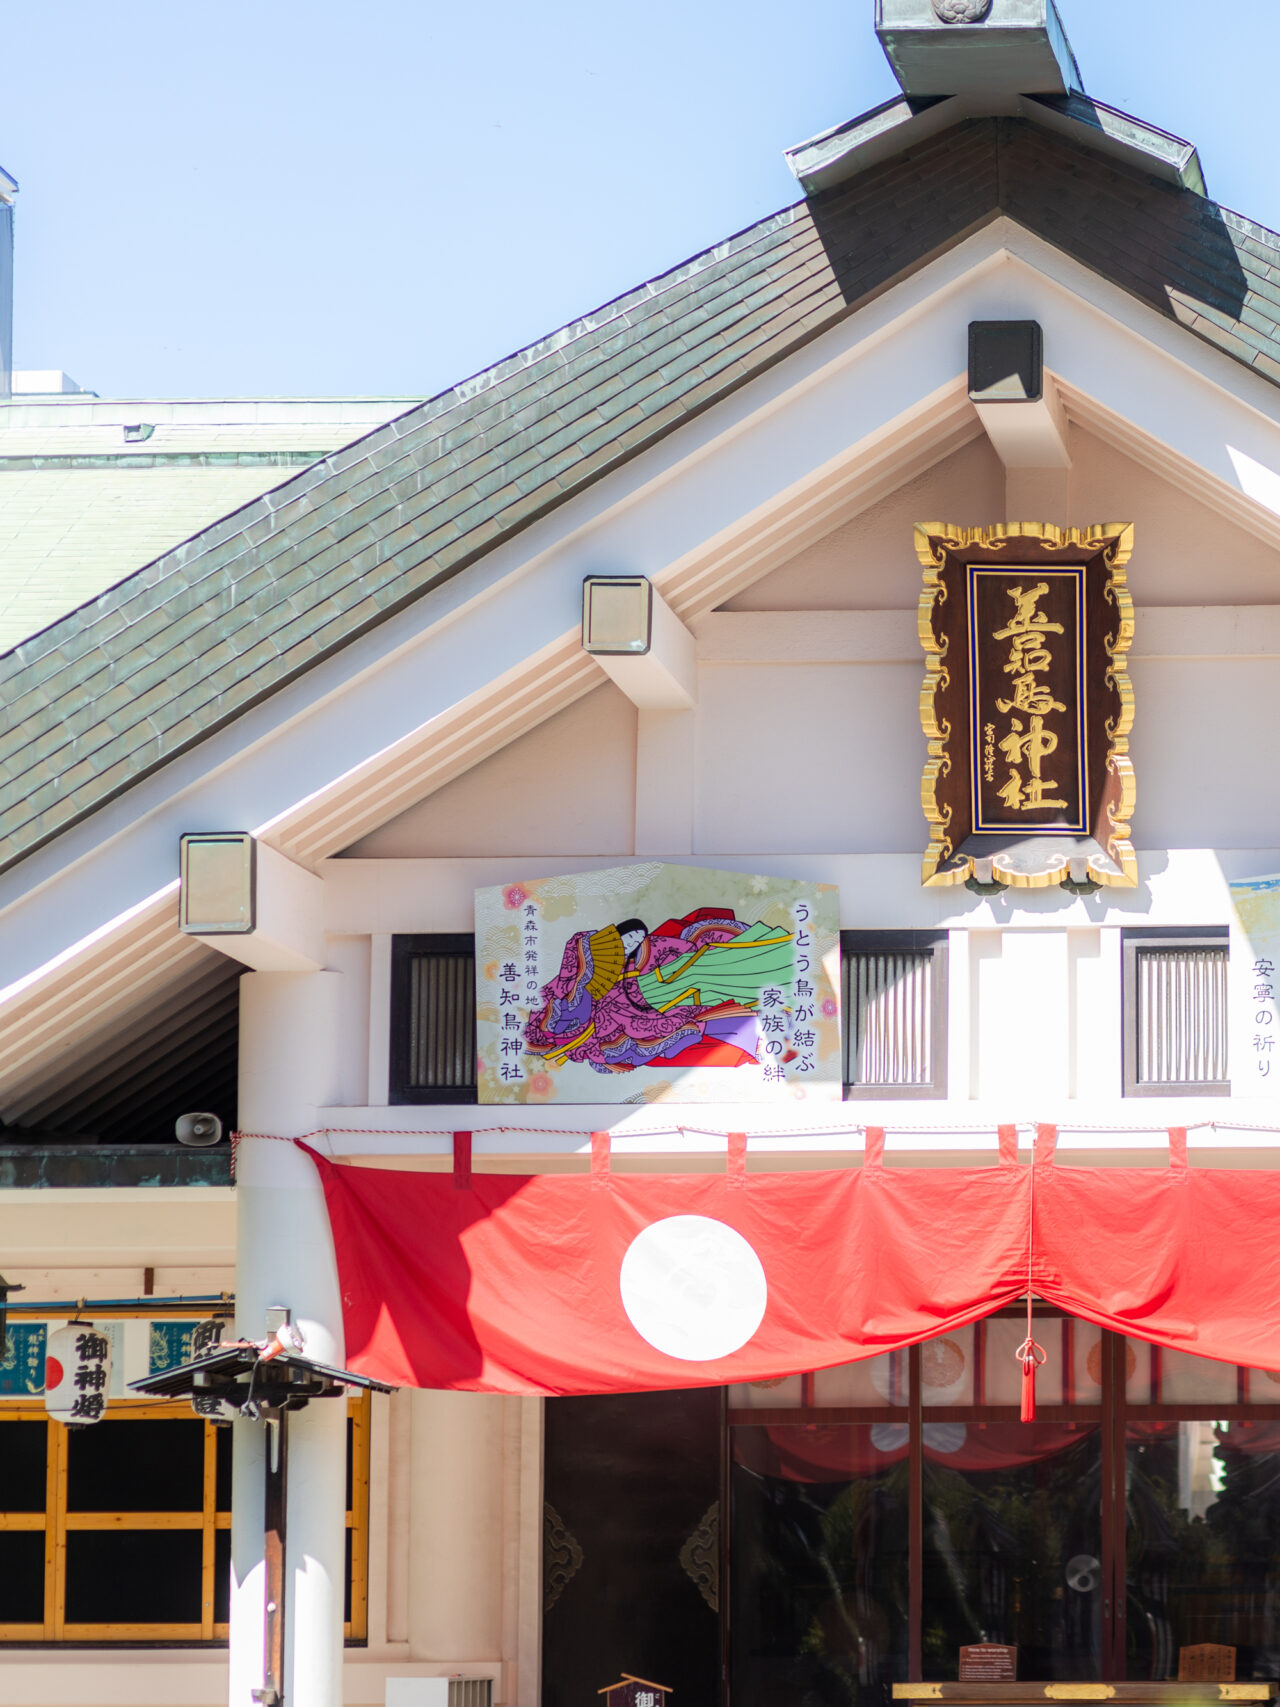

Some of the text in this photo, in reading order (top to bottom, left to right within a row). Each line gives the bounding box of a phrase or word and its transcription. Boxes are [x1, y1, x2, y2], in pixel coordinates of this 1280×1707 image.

[993, 582, 1068, 811] 善知鳥神社
[523, 904, 541, 1007] 青森市発祥の地
[793, 904, 816, 1072] うとう鳥が結ぶ
[499, 962, 524, 1081] 善知鳥神社
[762, 987, 786, 1083] 家族の絆
[1251, 958, 1276, 1078] 安寧の祈り
[70, 1332, 109, 1420] 御神燈
